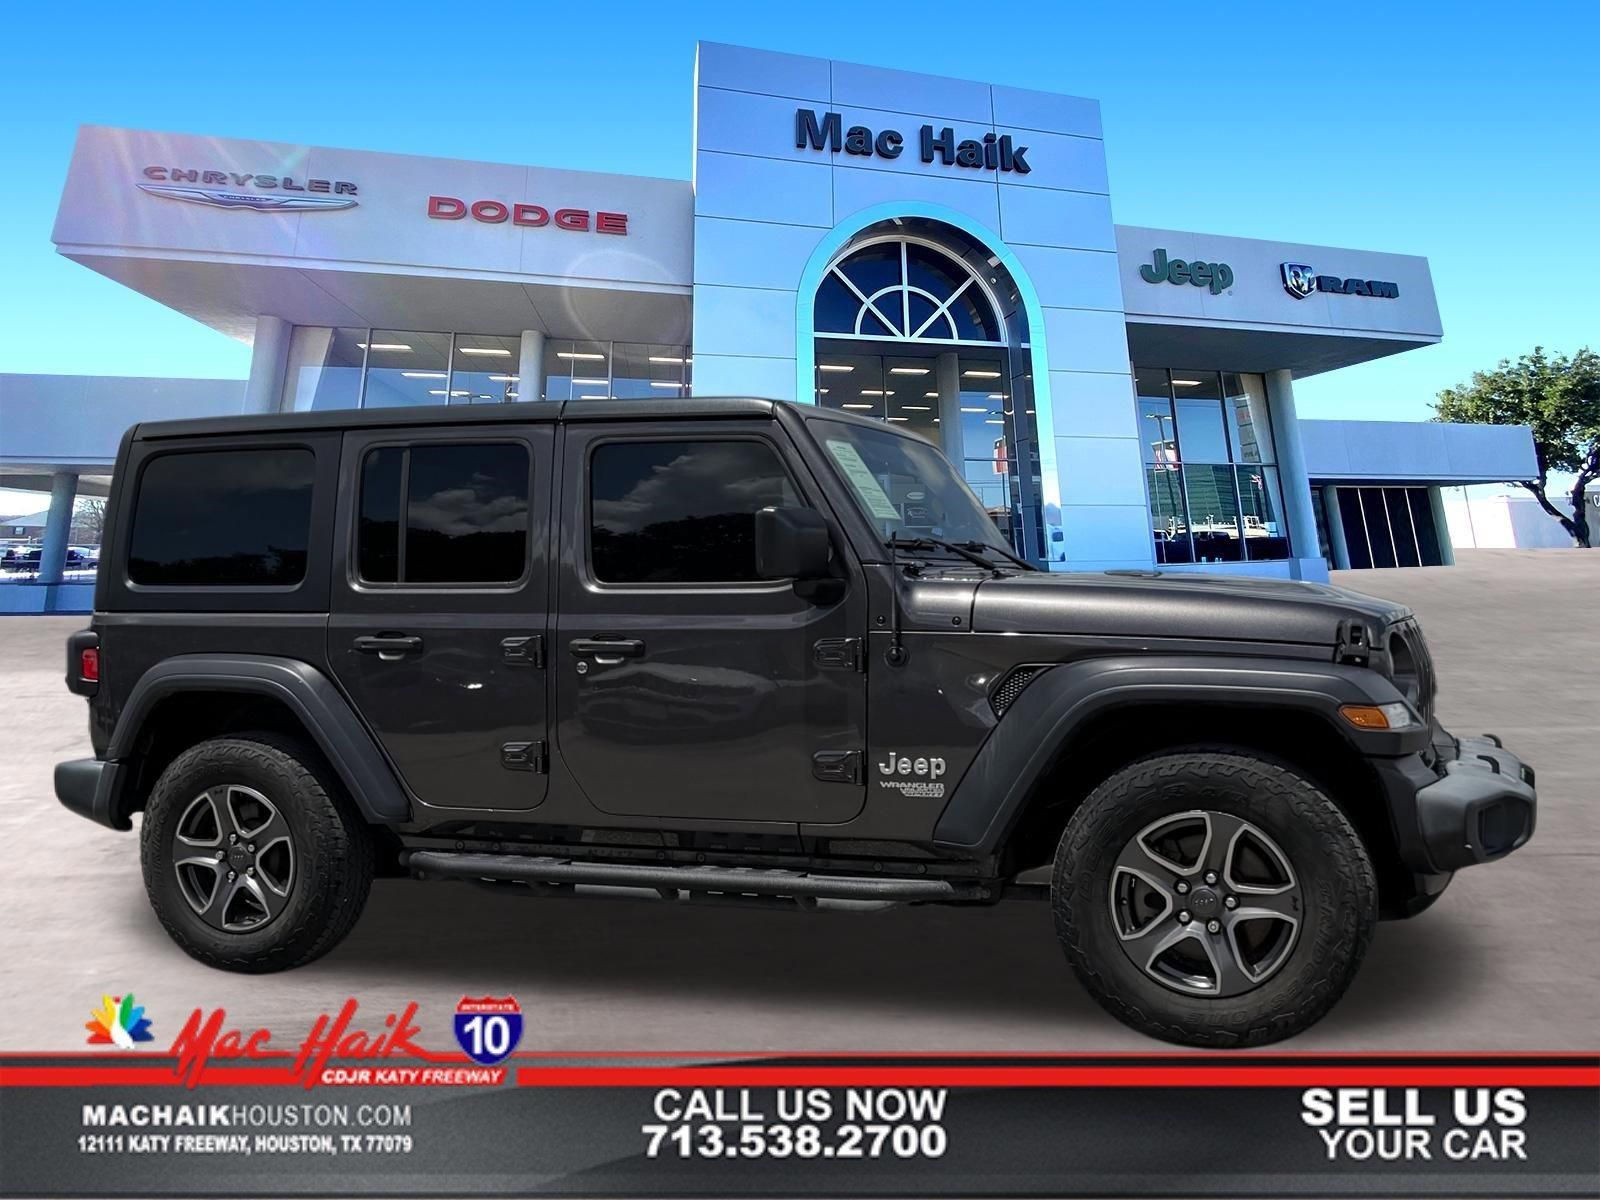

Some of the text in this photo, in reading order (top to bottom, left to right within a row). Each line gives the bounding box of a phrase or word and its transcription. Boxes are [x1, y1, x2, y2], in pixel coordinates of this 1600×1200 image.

[795, 108, 1032, 175] Mac Haik
[143, 166, 358, 196] CHRYSLER
[428, 195, 628, 236] DODGE
[1140, 248, 1234, 296] Jeep
[1316, 275, 1400, 299] RAM
[879, 752, 946, 780] Jeep
